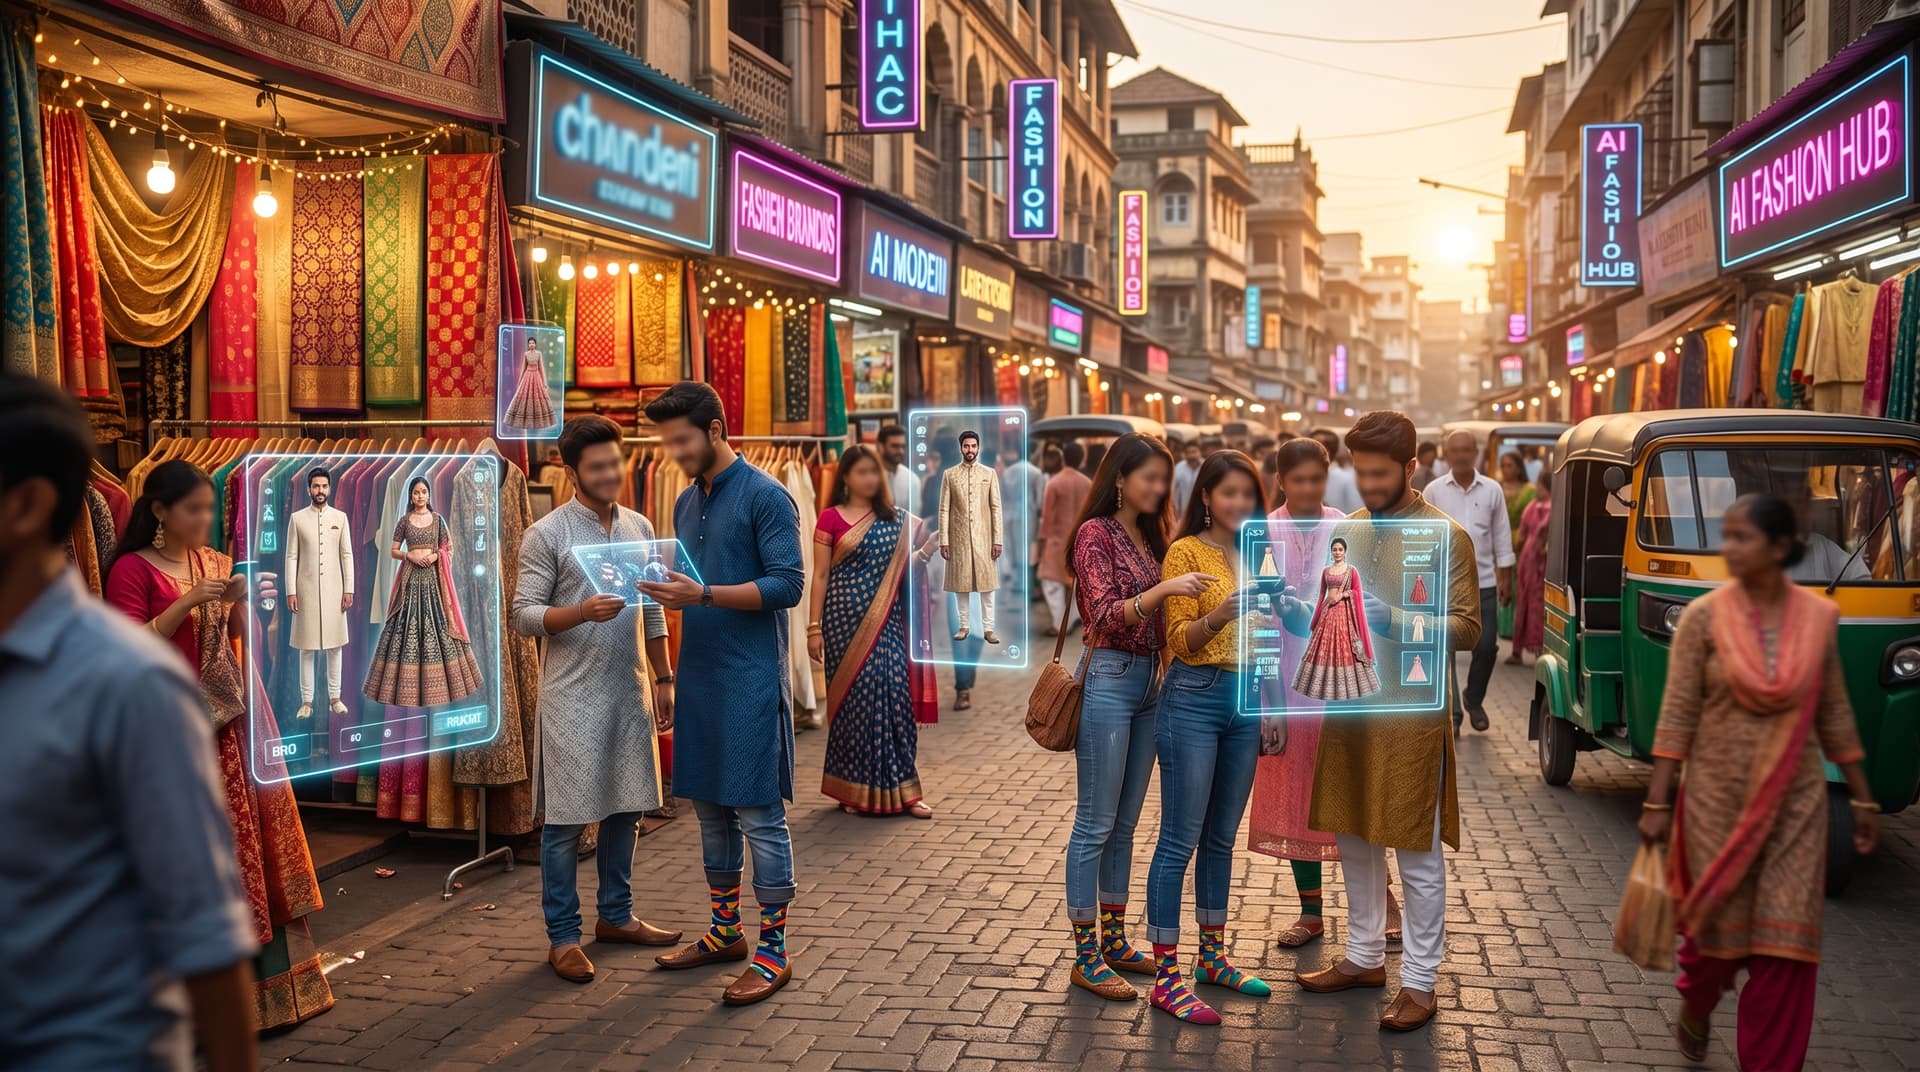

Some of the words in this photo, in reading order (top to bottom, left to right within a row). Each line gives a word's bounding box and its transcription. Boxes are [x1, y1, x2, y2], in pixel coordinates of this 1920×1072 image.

[1023, 86, 1045, 228] FASHION
[1596, 130, 1626, 152] AI
[1730, 177, 1747, 235] AI
[1751, 130, 1832, 225] FASHION
[1840, 100, 1891, 185] HUB
[741, 180, 785, 239] FASHEN
[1603, 154, 1621, 259] FASHIO
[870, 231, 889, 279] AI
[1588, 262, 1635, 278] HUB
[272, 743, 297, 758] BRO
